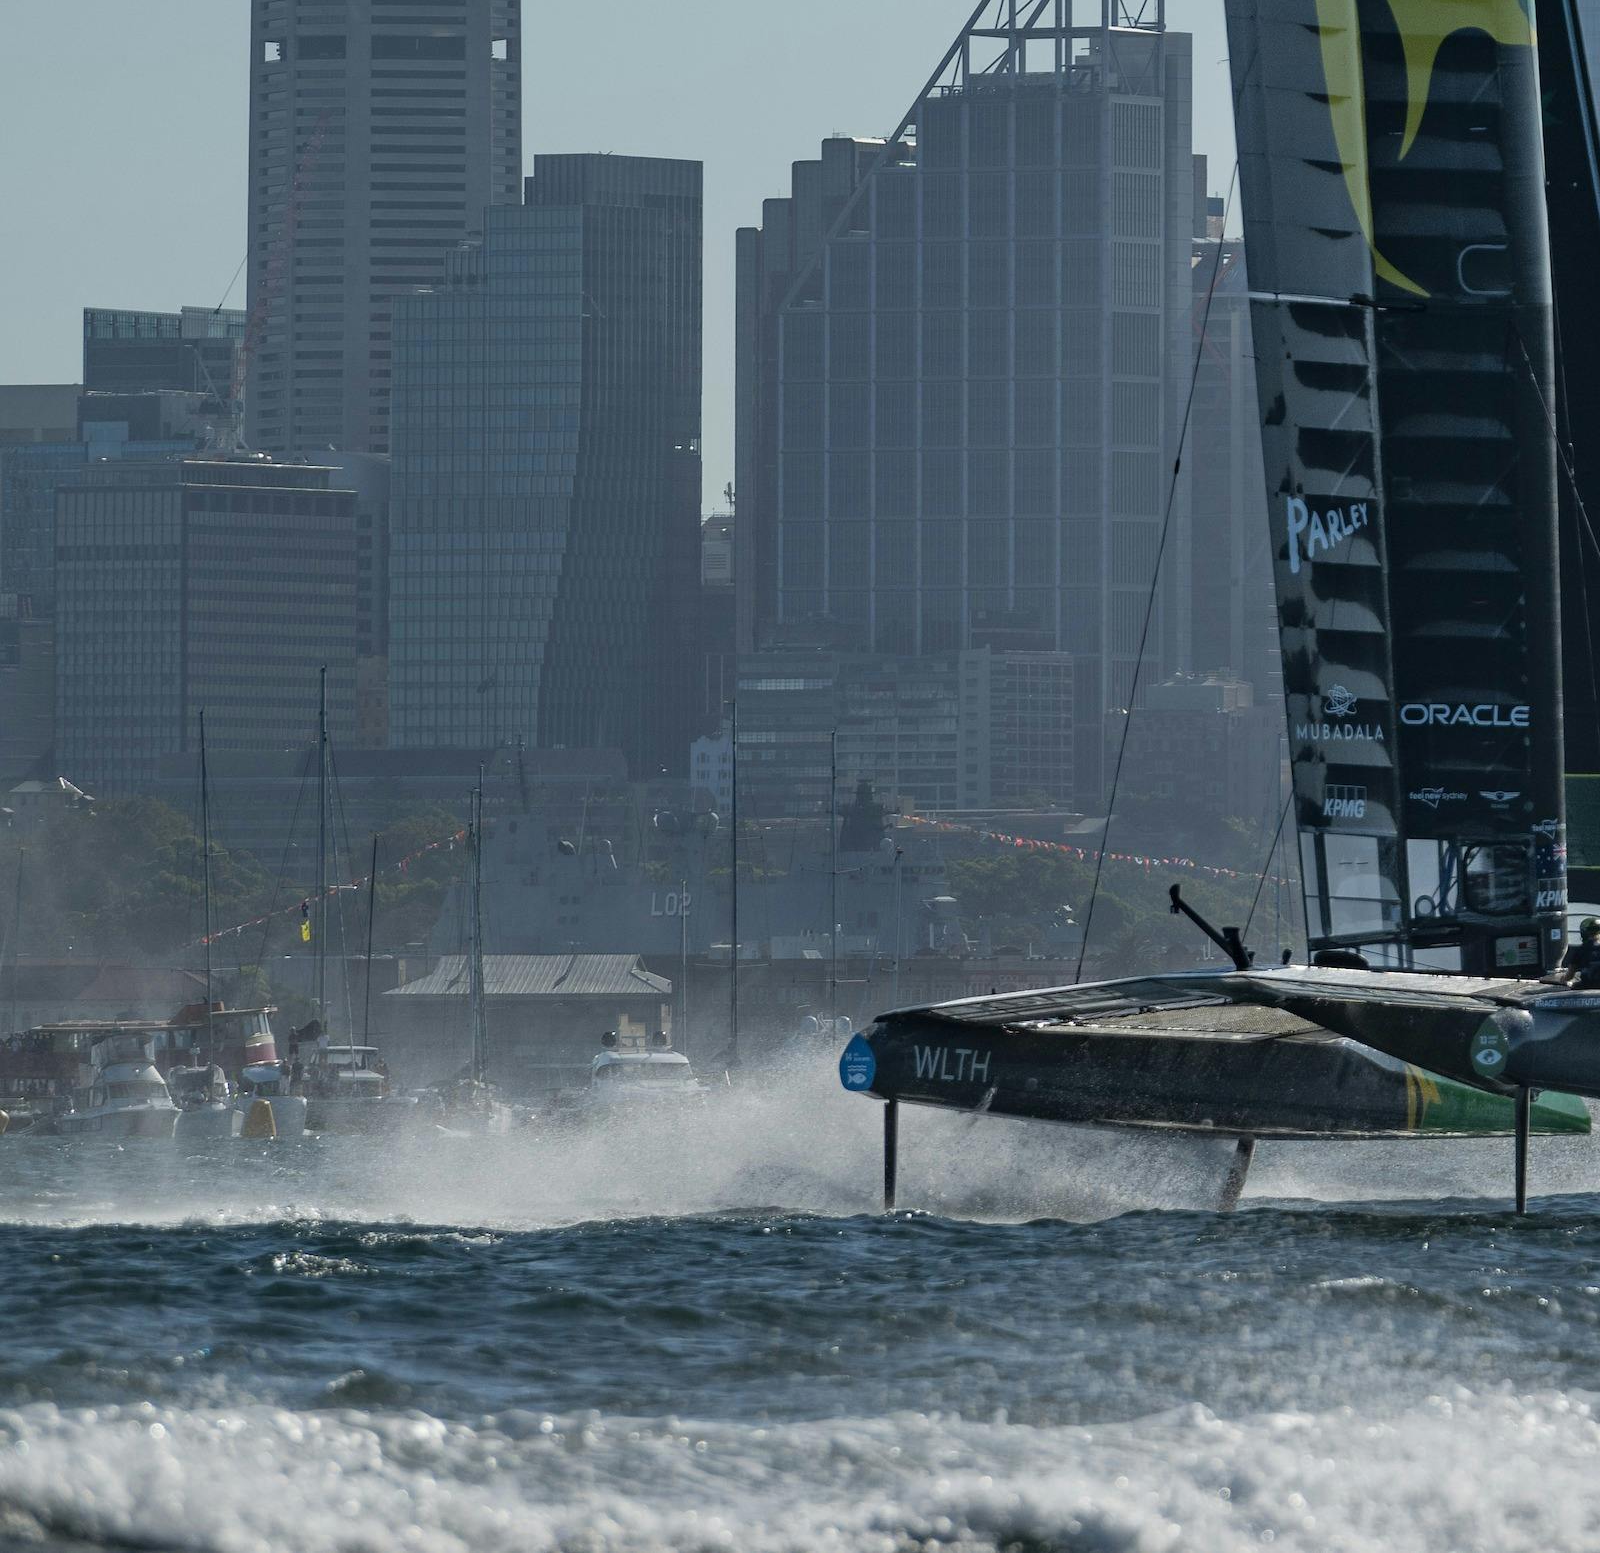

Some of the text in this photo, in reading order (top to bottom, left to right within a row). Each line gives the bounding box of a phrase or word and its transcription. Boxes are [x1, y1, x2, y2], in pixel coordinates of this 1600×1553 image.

[1287, 496, 1368, 573] PARLEY
[1400, 704, 1530, 727] ORACLE
[1296, 723, 1384, 740] MUBADALA
[1323, 799, 1365, 818] KPMG
[1536, 889, 1568, 907] KPM
[914, 1045, 991, 1083] WLTH
